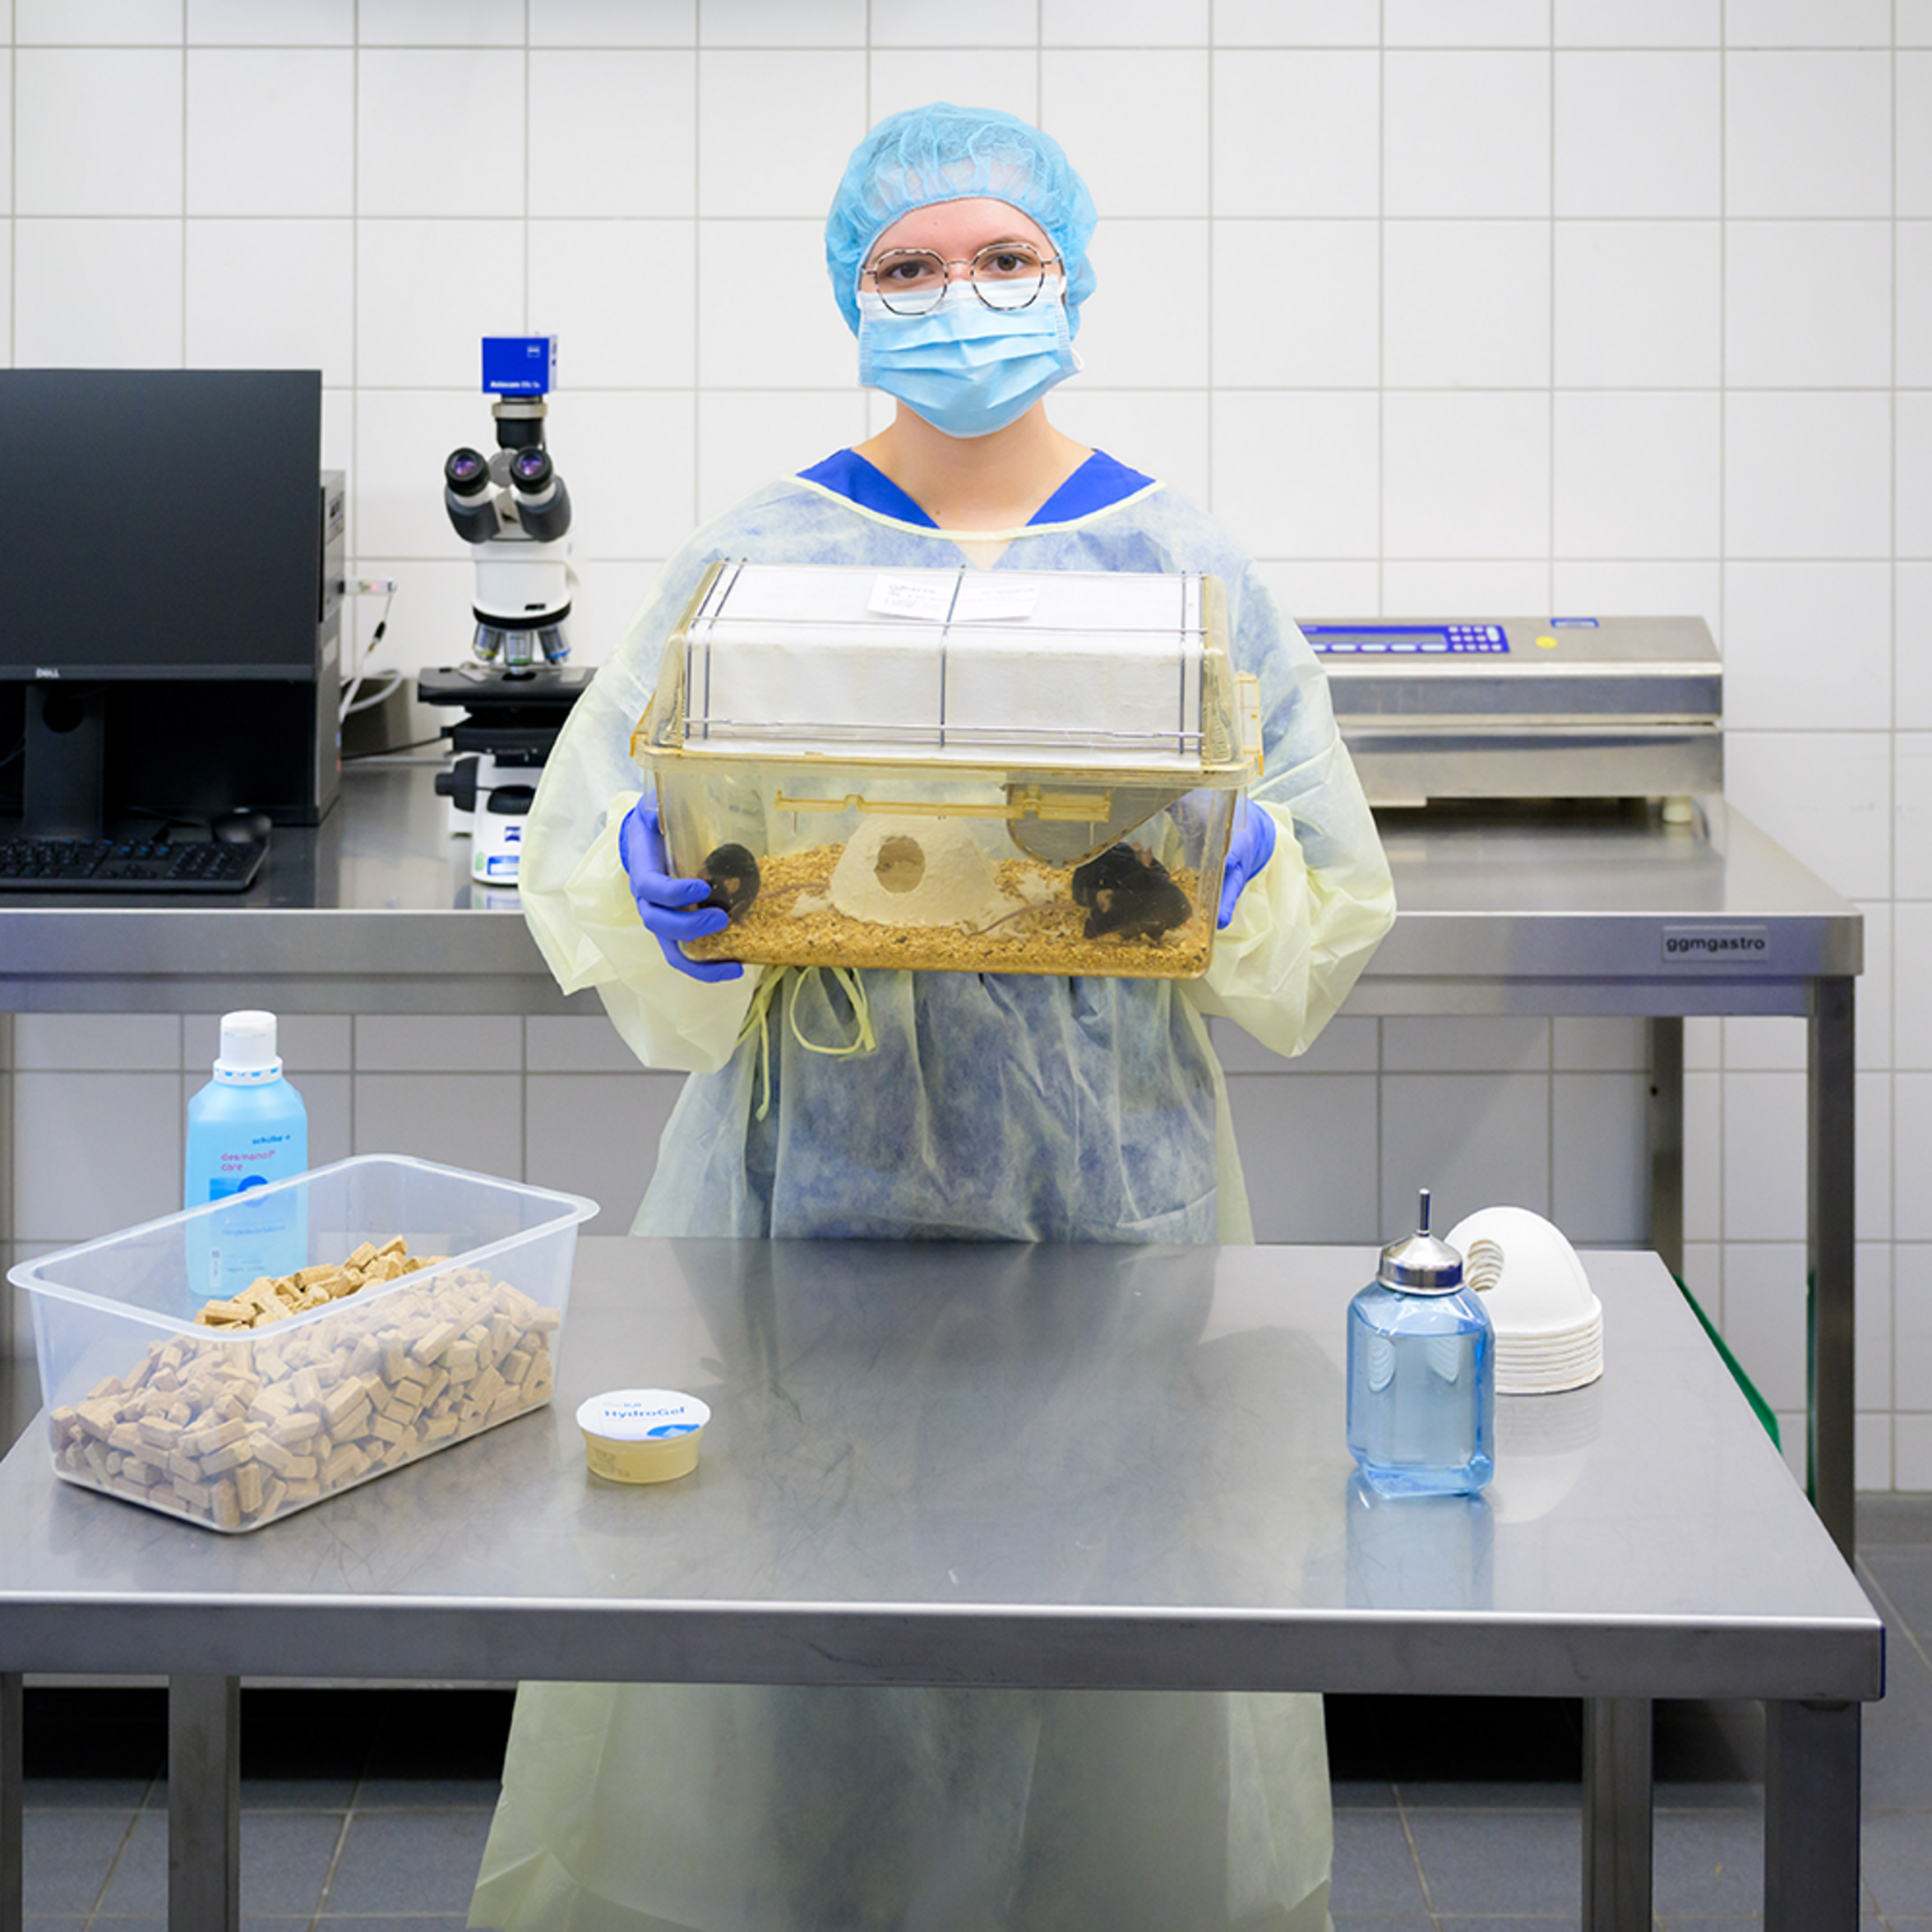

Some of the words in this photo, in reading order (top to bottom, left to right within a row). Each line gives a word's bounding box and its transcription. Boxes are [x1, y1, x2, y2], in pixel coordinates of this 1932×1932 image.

[1666, 936, 1765, 952] ggmgastro
[220, 1163, 243, 1172] care
[604, 1407, 685, 1418] HydroGel
